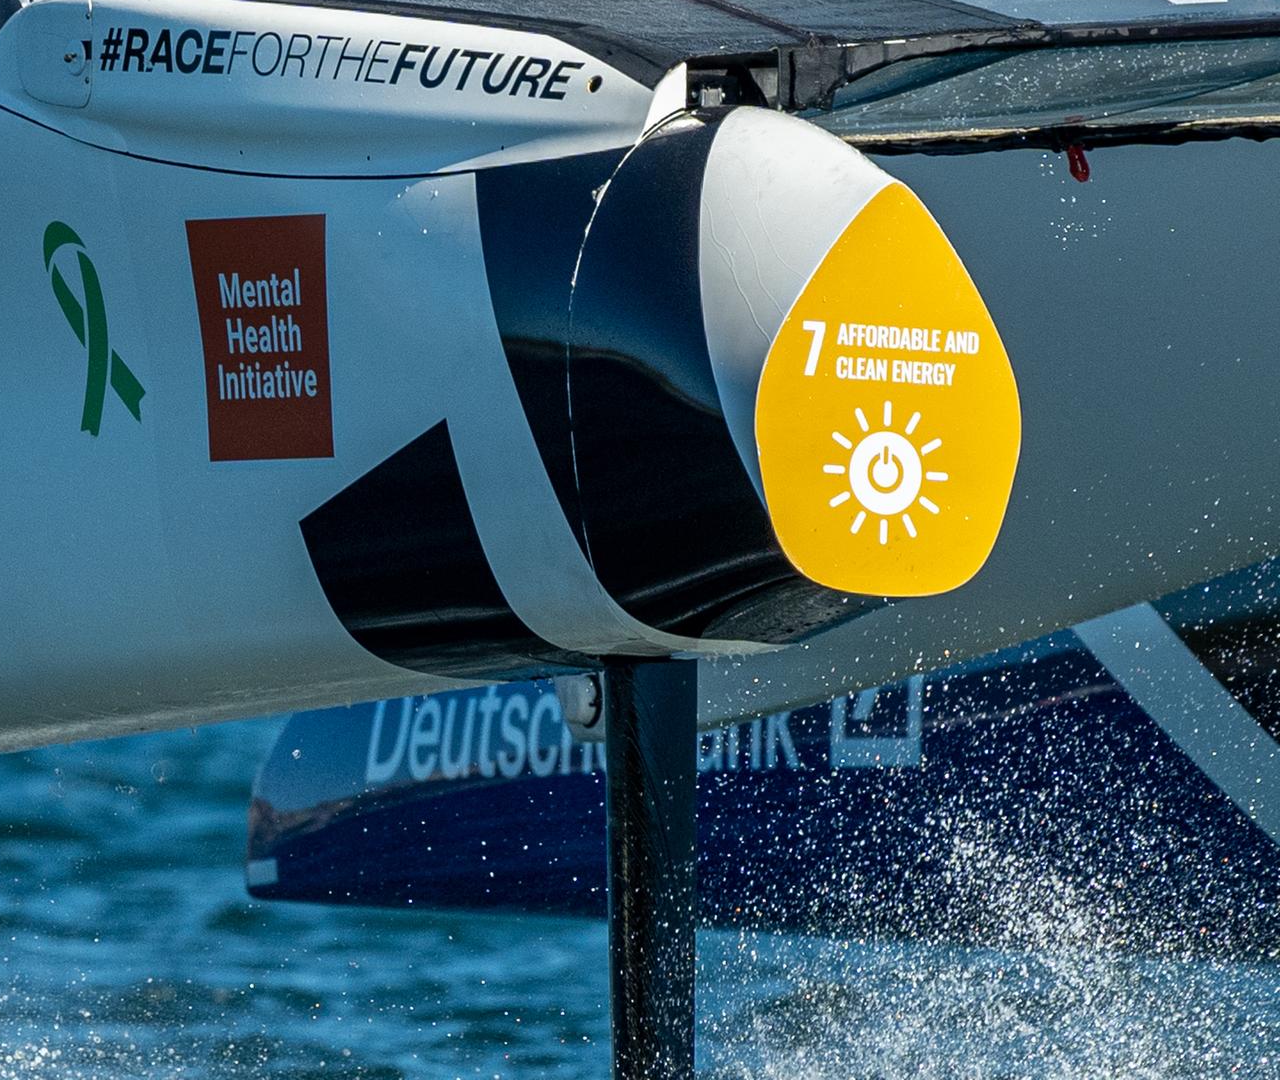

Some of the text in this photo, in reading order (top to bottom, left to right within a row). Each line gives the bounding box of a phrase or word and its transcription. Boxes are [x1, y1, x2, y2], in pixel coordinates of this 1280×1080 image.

[100, 27, 585, 101] #RACEFORTHEFUTURE
[218, 268, 301, 309] Mental
[225, 318, 303, 354] Health
[802, 320, 980, 376] 7 AFFORDABLE AND
[217, 361, 318, 401] Initiative
[836, 355, 956, 386] CLEAN ENERGY
